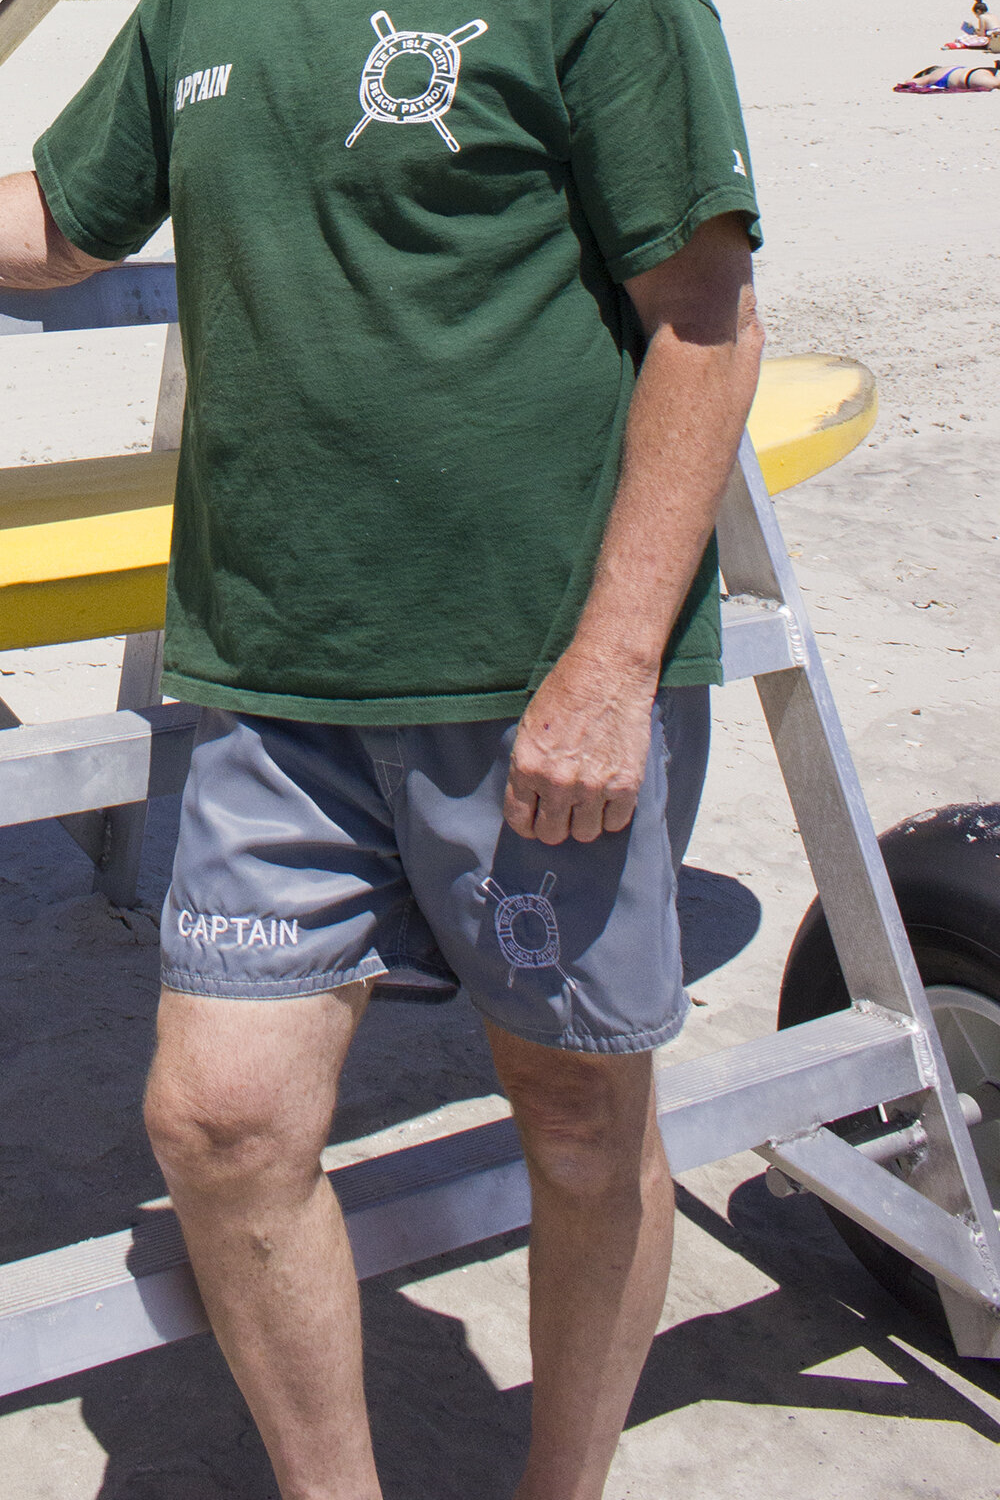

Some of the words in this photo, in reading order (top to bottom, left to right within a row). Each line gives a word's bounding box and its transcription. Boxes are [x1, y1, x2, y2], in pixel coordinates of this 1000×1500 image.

[374, 46, 397, 68] SEA
[402, 40, 431, 50] ISLE
[432, 48, 448, 71] CITY
[174, 63, 233, 114] APTAIN
[370, 82, 397, 113] BEACH
[401, 85, 444, 114] PATROL
[178, 909, 298, 946] CAPTAIN
